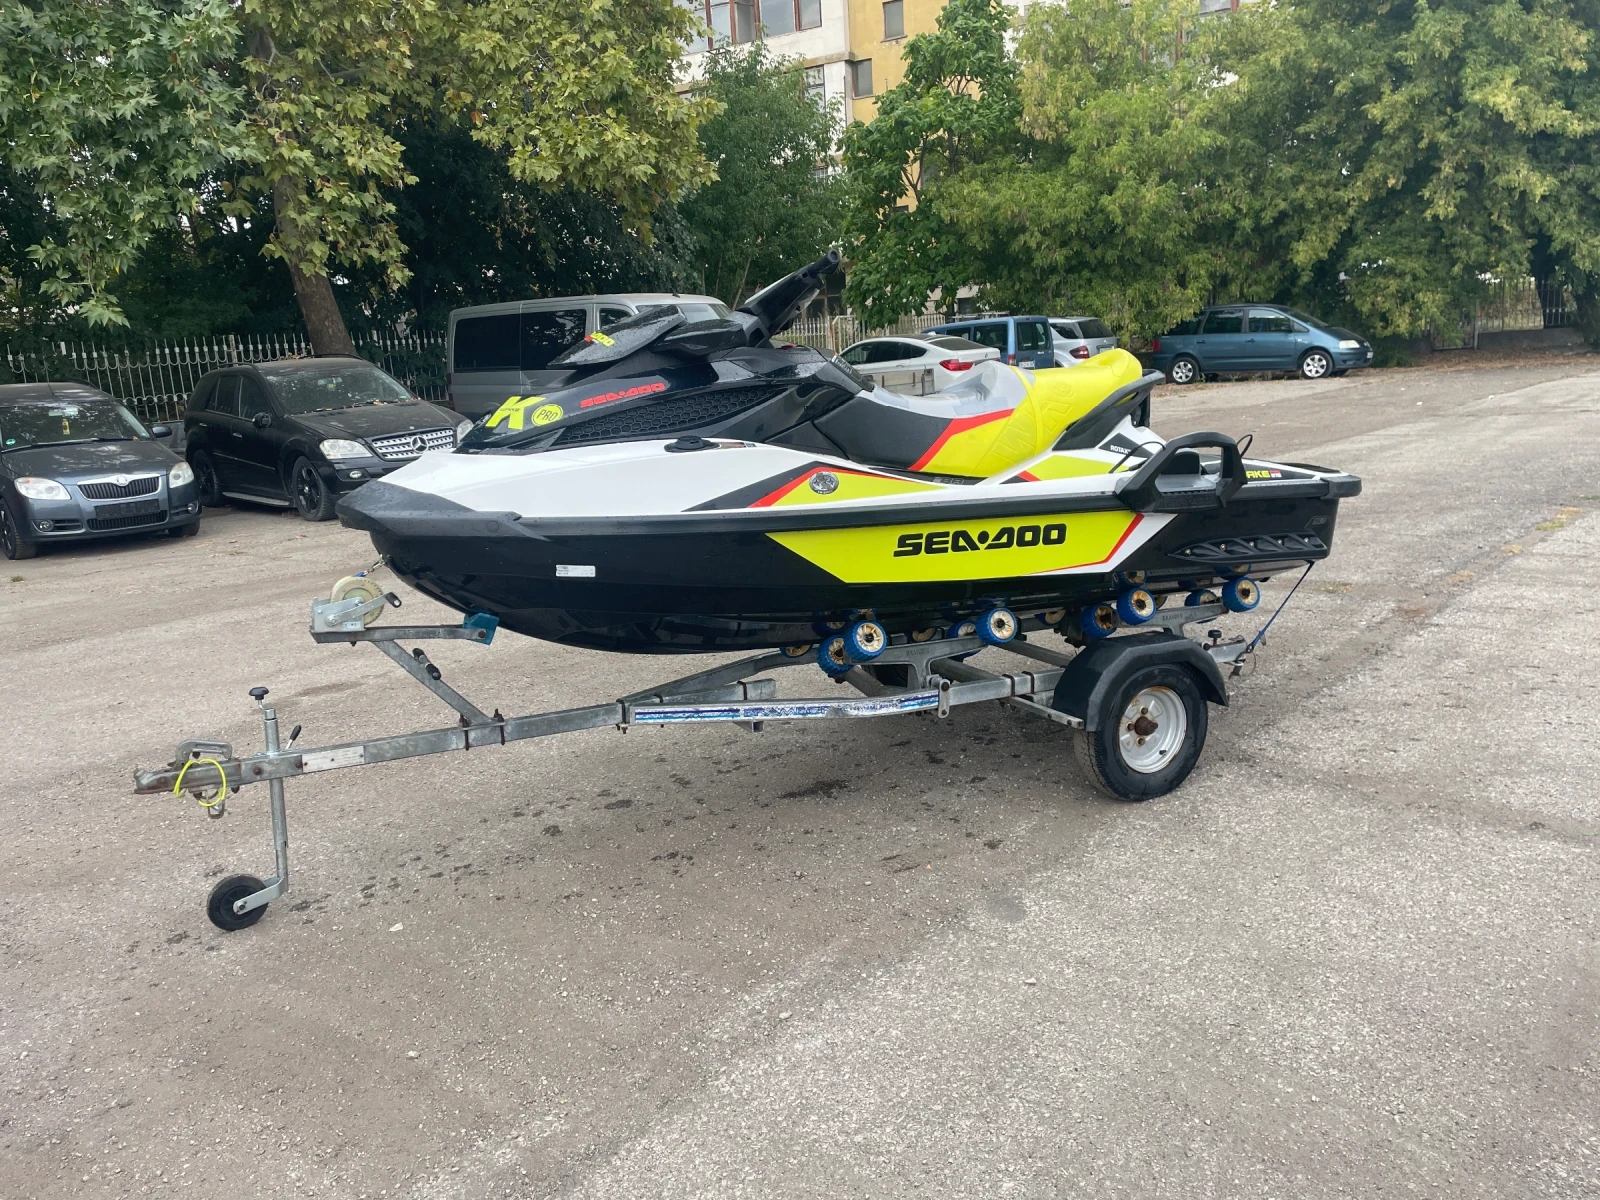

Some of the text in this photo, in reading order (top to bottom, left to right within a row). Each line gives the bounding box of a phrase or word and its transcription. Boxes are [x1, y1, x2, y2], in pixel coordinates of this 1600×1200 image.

[485, 396, 546, 430] K
[536, 409, 559, 422] PRO
[1245, 470, 1270, 479] AKE
